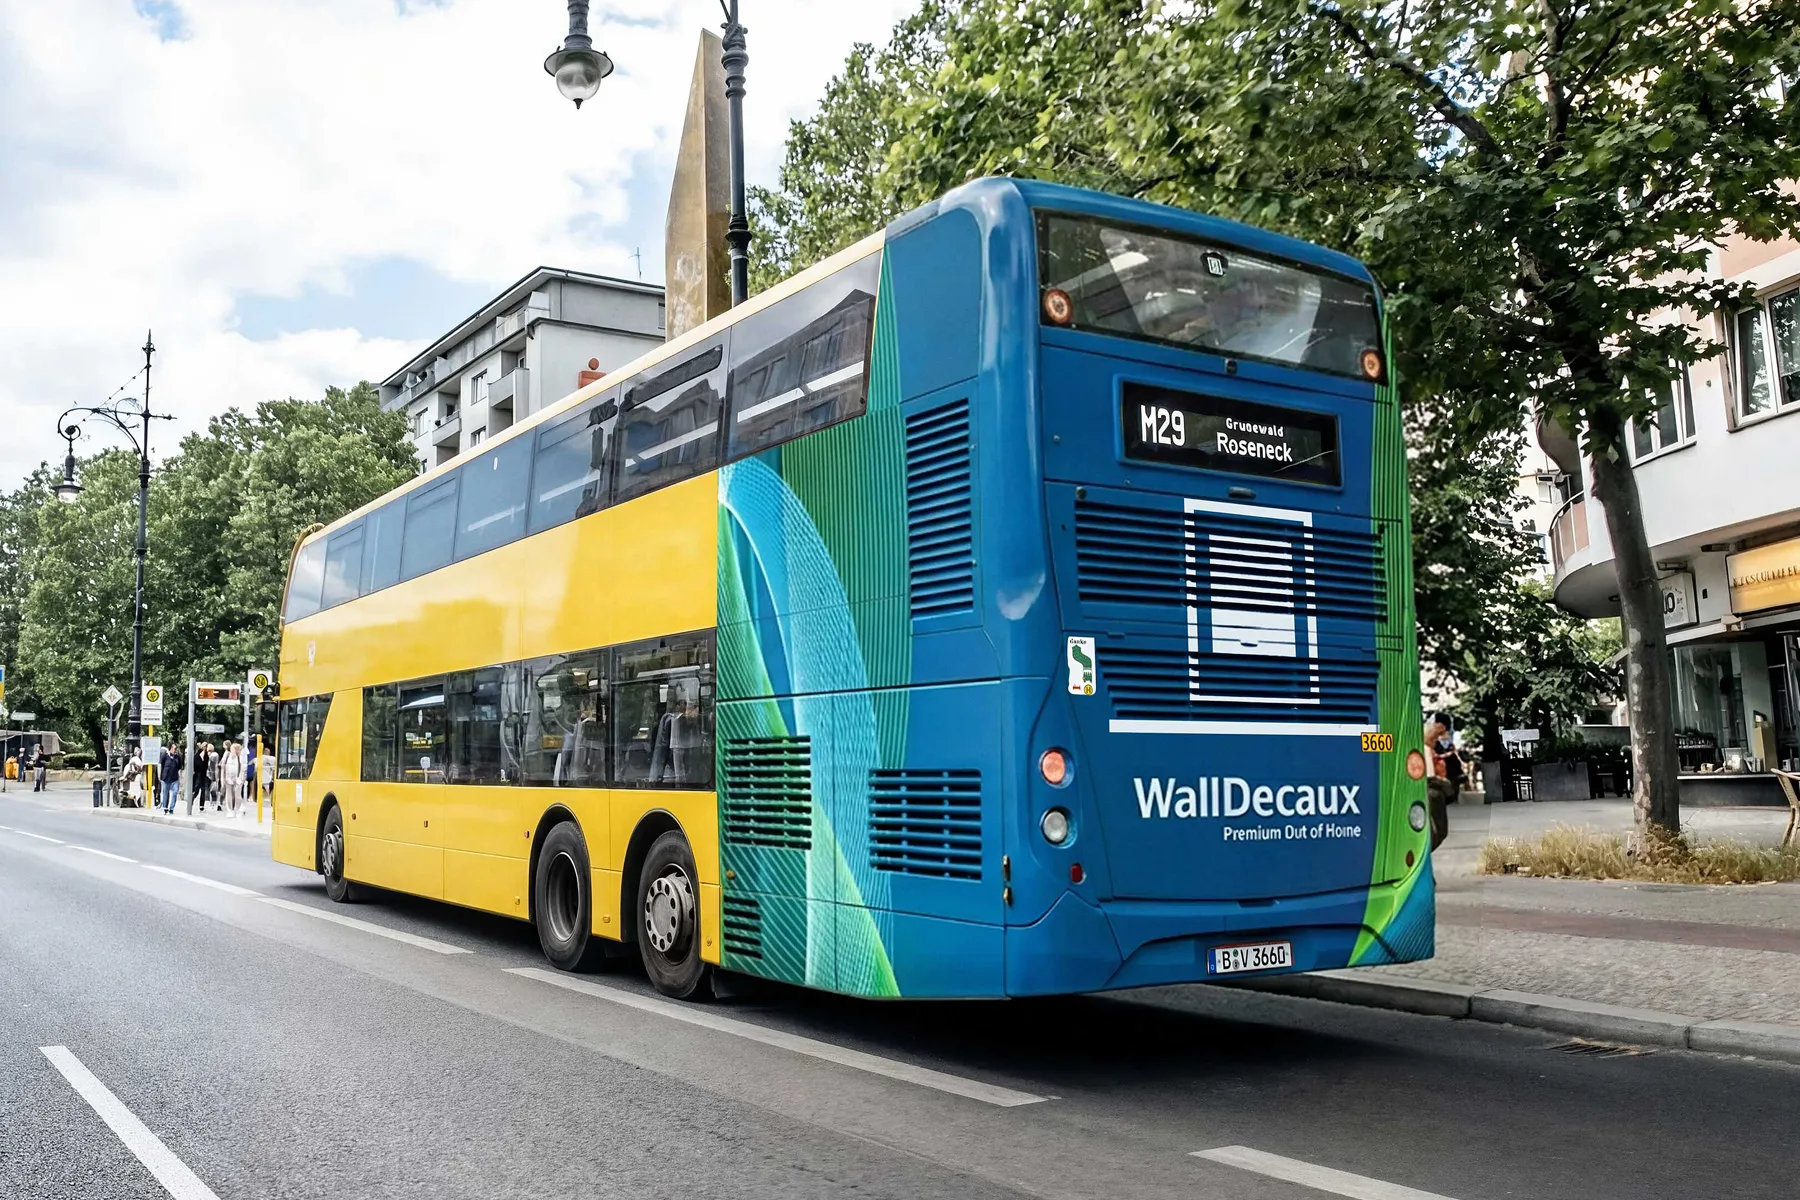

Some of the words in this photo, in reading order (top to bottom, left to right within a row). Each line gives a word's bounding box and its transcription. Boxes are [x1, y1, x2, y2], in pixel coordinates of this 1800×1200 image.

[1140, 404, 1186, 447] M29
[1216, 431, 1293, 462] Roseneck
[1362, 734, 1392, 751] 3660
[1133, 776, 1361, 819] WallDecaux
[1223, 824, 1282, 841] Premium
[1285, 824, 1307, 840] Out
[1309, 823, 1324, 839] of
[1326, 823, 1361, 839] Home
[1222, 951, 1231, 969] B
[1240, 948, 1249, 968] V
[1253, 946, 1285, 966] 3660
